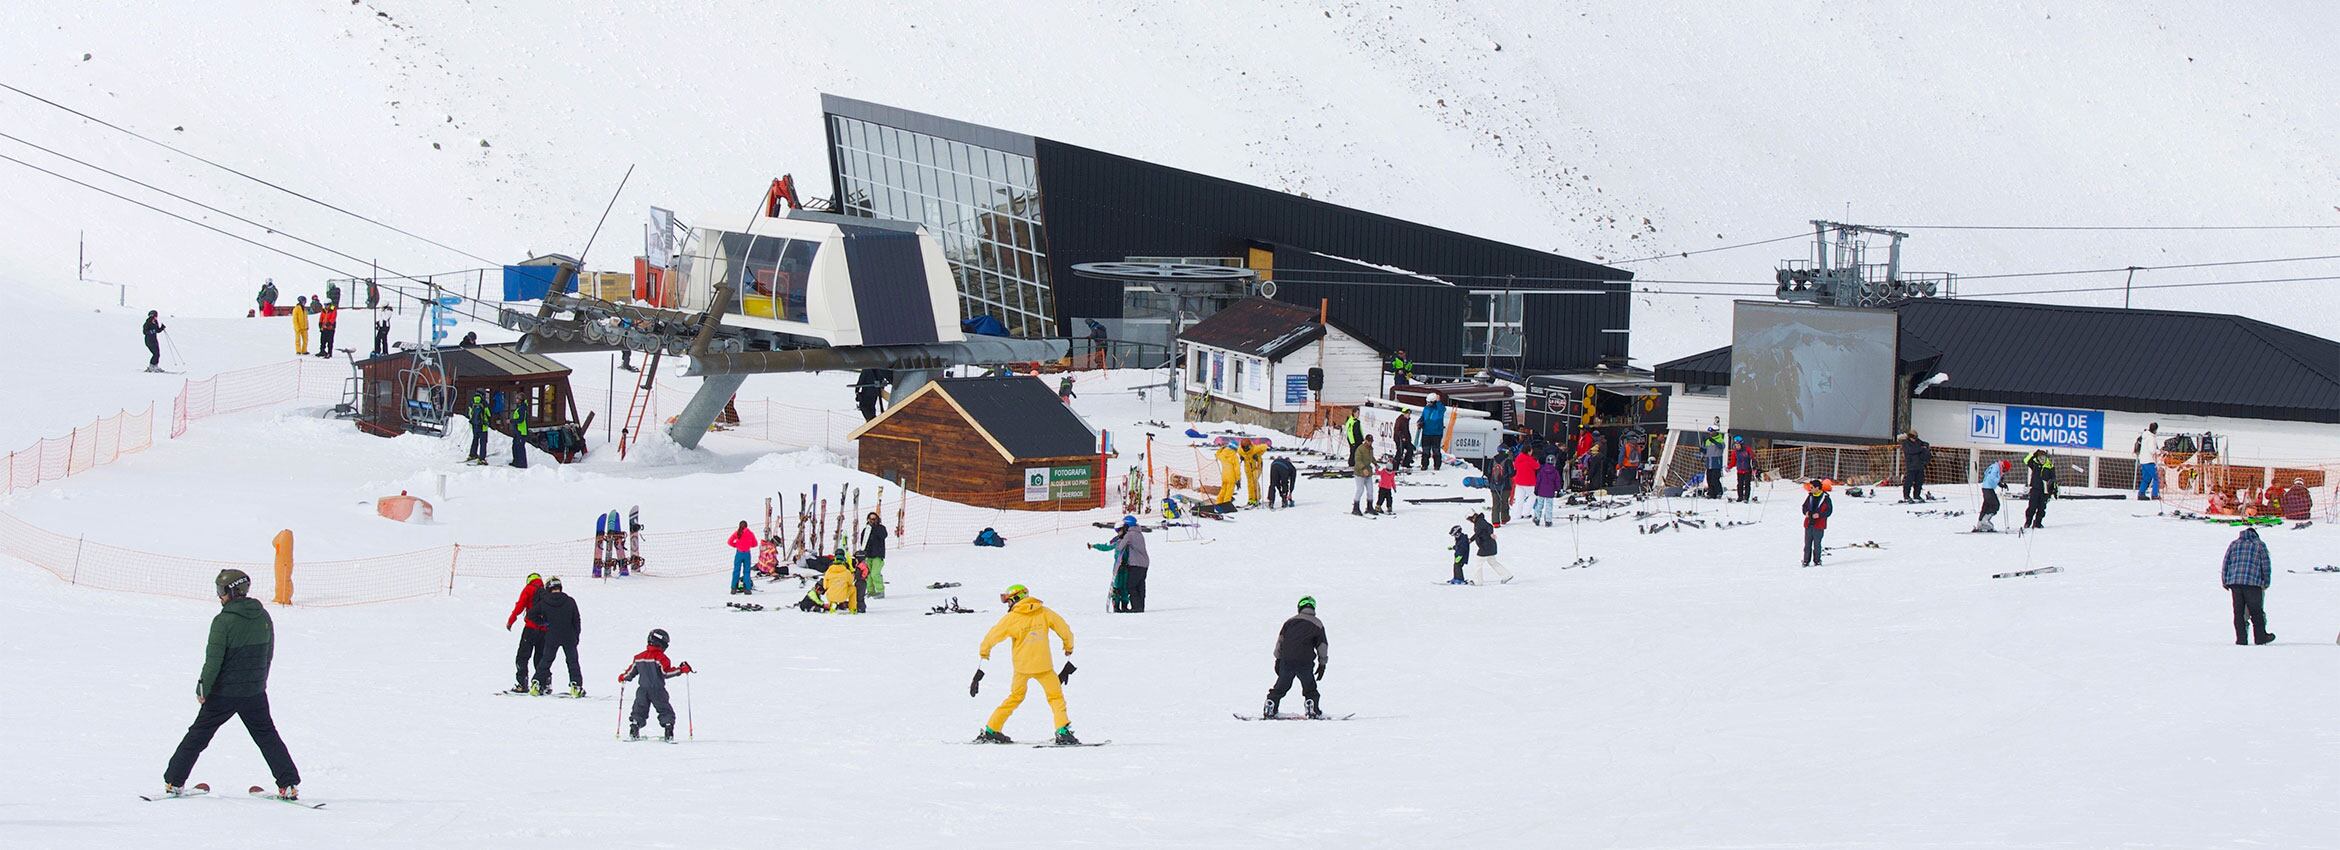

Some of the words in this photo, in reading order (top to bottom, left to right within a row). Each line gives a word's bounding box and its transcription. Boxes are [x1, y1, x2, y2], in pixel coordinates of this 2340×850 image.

[2020, 411, 2064, 427] PATIO
[2067, 414, 2088, 429] DE
[2020, 427, 2088, 444] COMIDAS
[1455, 438, 1480, 447] COSAMA
[1054, 468, 1087, 476] FOTOGRAFIA
[228, 576, 248, 588] uvex
